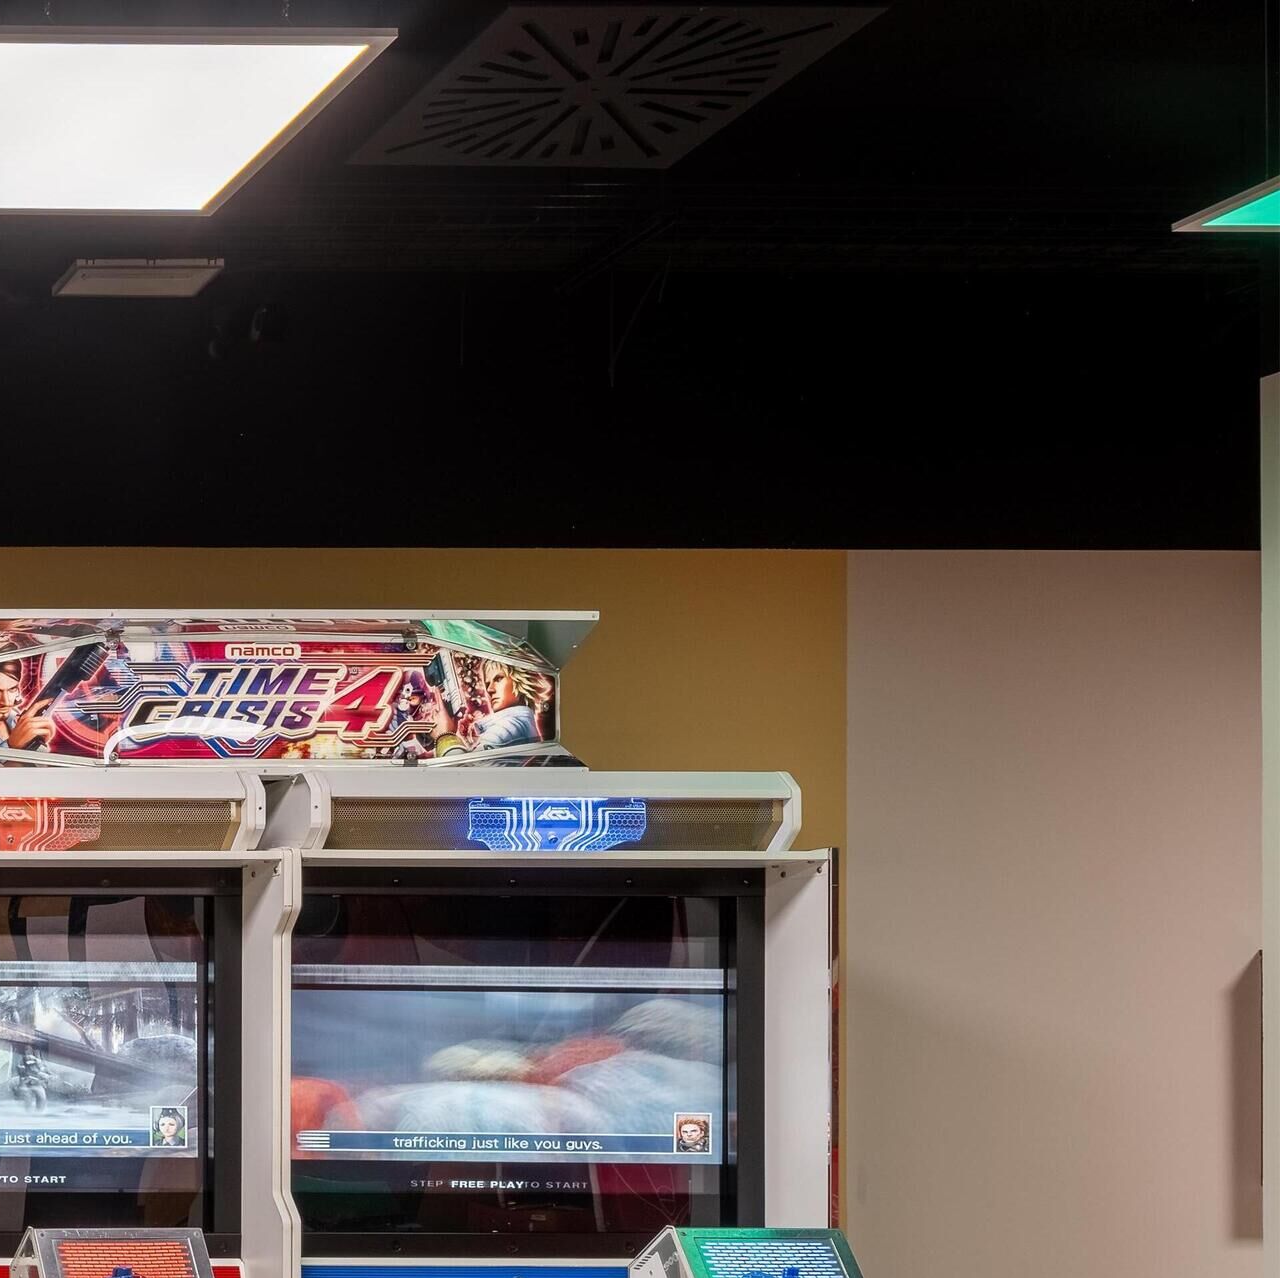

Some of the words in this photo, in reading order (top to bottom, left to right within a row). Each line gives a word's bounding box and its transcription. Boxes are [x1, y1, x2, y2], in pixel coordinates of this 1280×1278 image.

[230, 646, 295, 657] namco
[193, 666, 342, 697] TIME
[126, 699, 324, 737] CRISIS
[330, 667, 396, 736] 4
[3, 1130, 31, 1147] just
[35, 1130, 79, 1144] ahead
[83, 1130, 100, 1144] of
[103, 1134, 133, 1147] you.
[393, 1136, 466, 1151] trafficking
[471, 1136, 499, 1151] just
[504, 1136, 529, 1150] like
[534, 1140, 561, 1152] you
[566, 1140, 603, 1152] guys.
[2, 1175, 19, 1183] TO
[24, 1175, 67, 1184] START
[410, 1180, 444, 1188] STEP
[545, 1181, 589, 1189] START
[451, 1180, 485, 1188] FREE
[490, 1180, 525, 1189] PLAY
